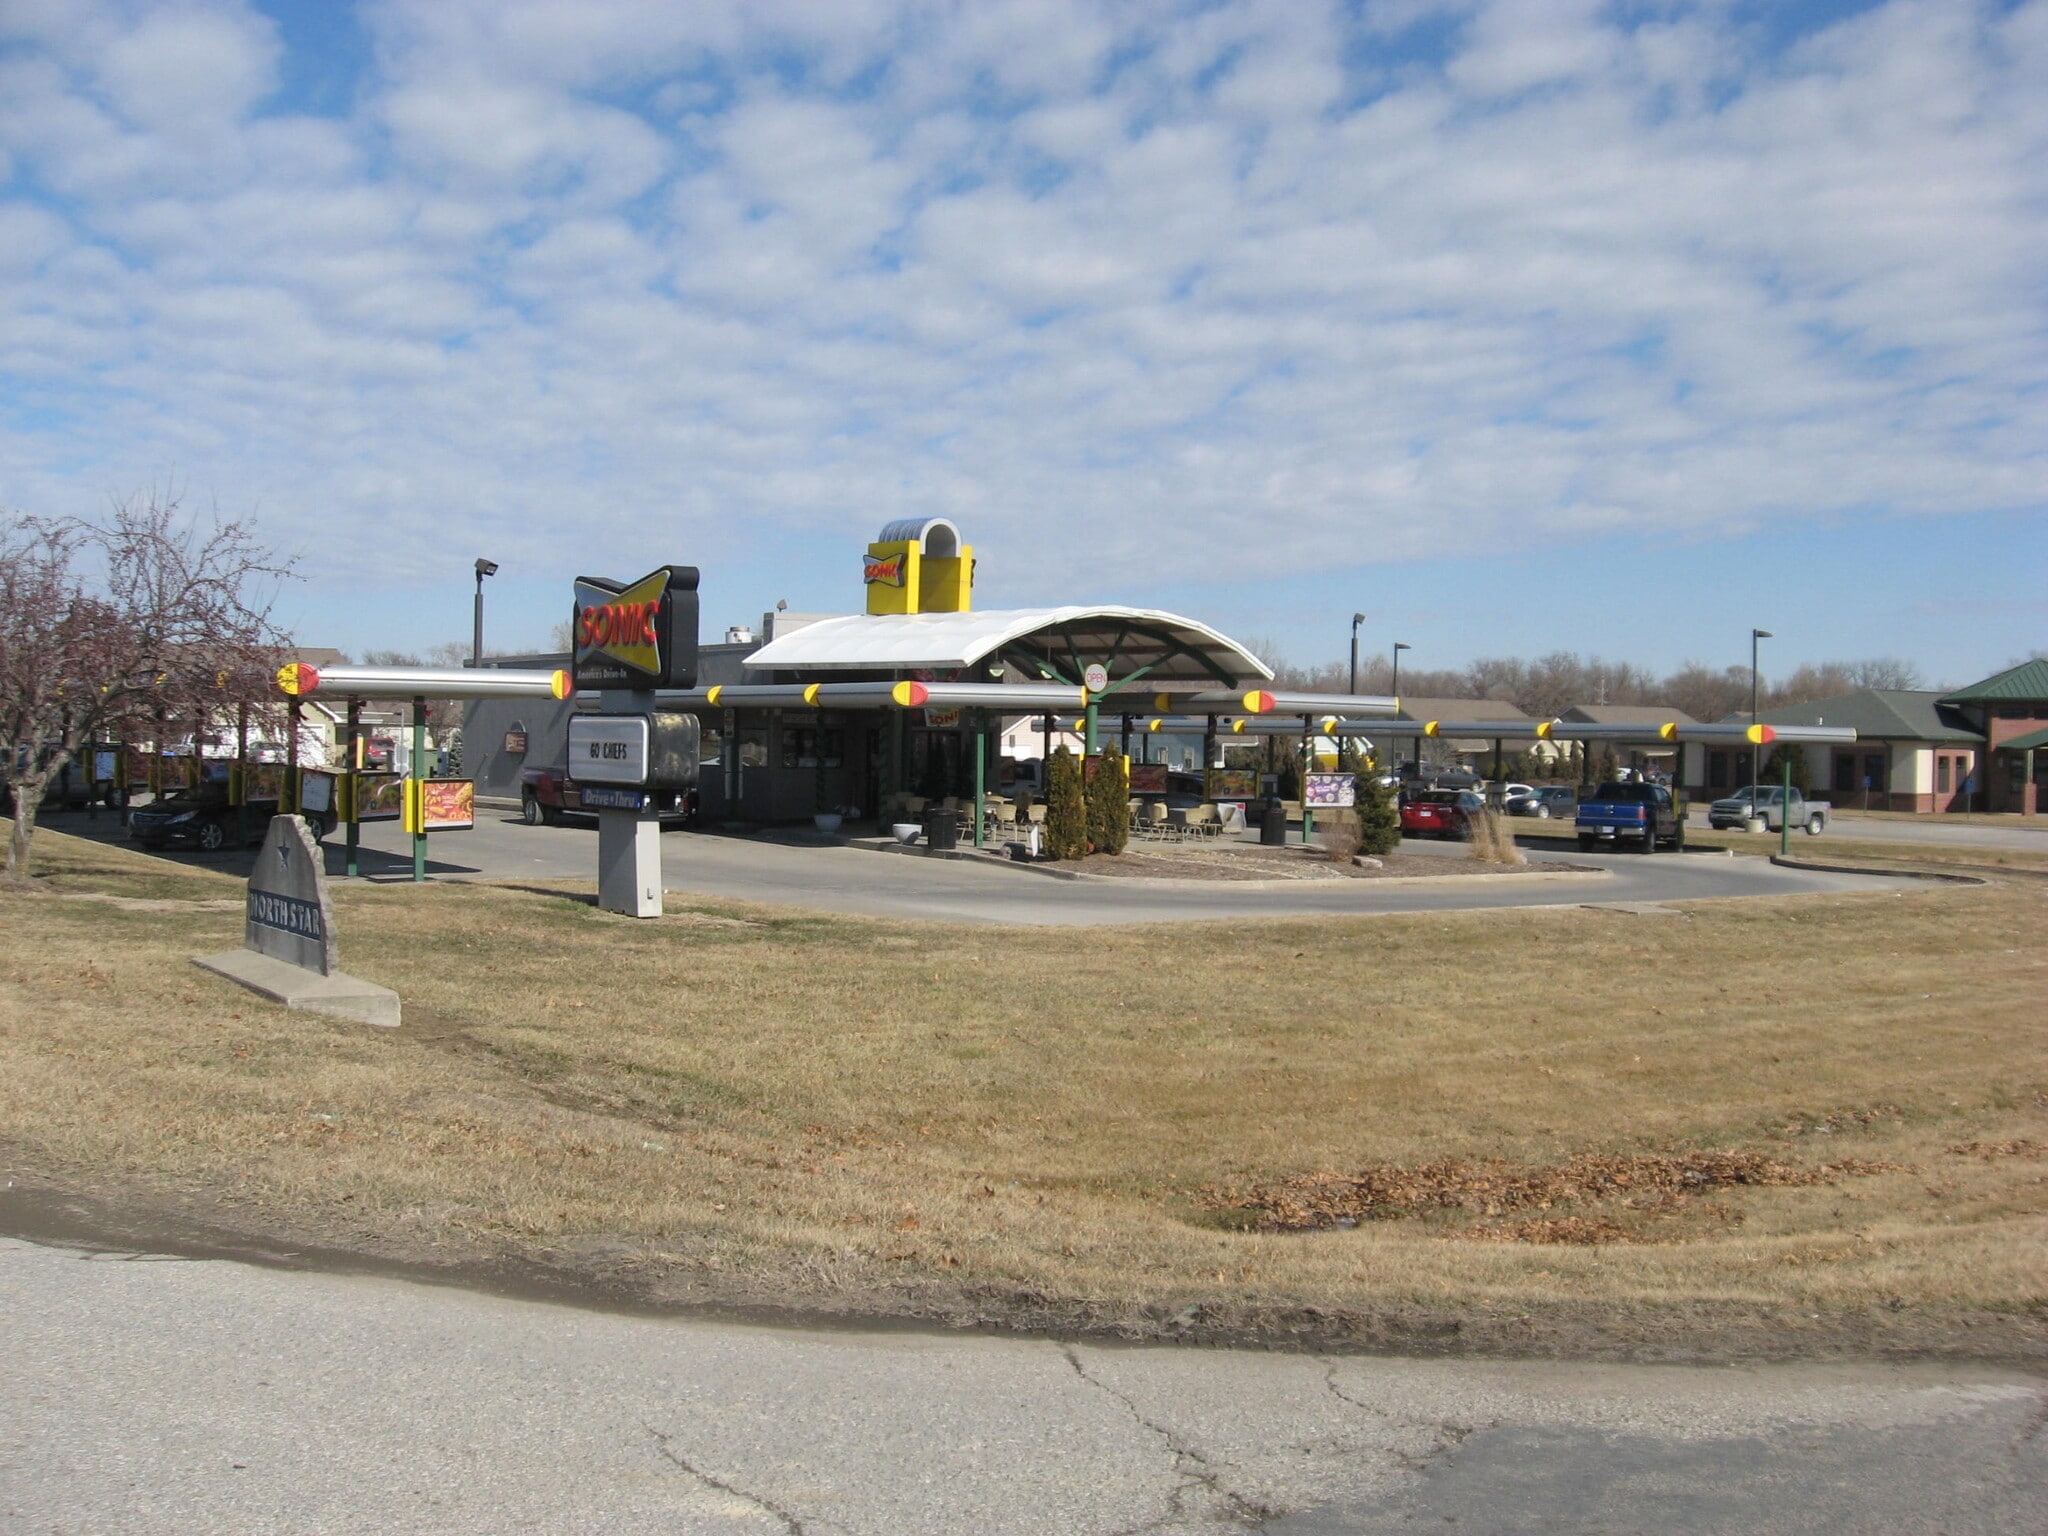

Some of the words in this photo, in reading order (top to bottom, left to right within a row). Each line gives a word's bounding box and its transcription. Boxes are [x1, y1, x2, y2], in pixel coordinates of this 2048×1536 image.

[864, 564, 901, 578] SONIC
[577, 600, 661, 647] SONIC
[603, 742, 627, 759] CHIEFS
